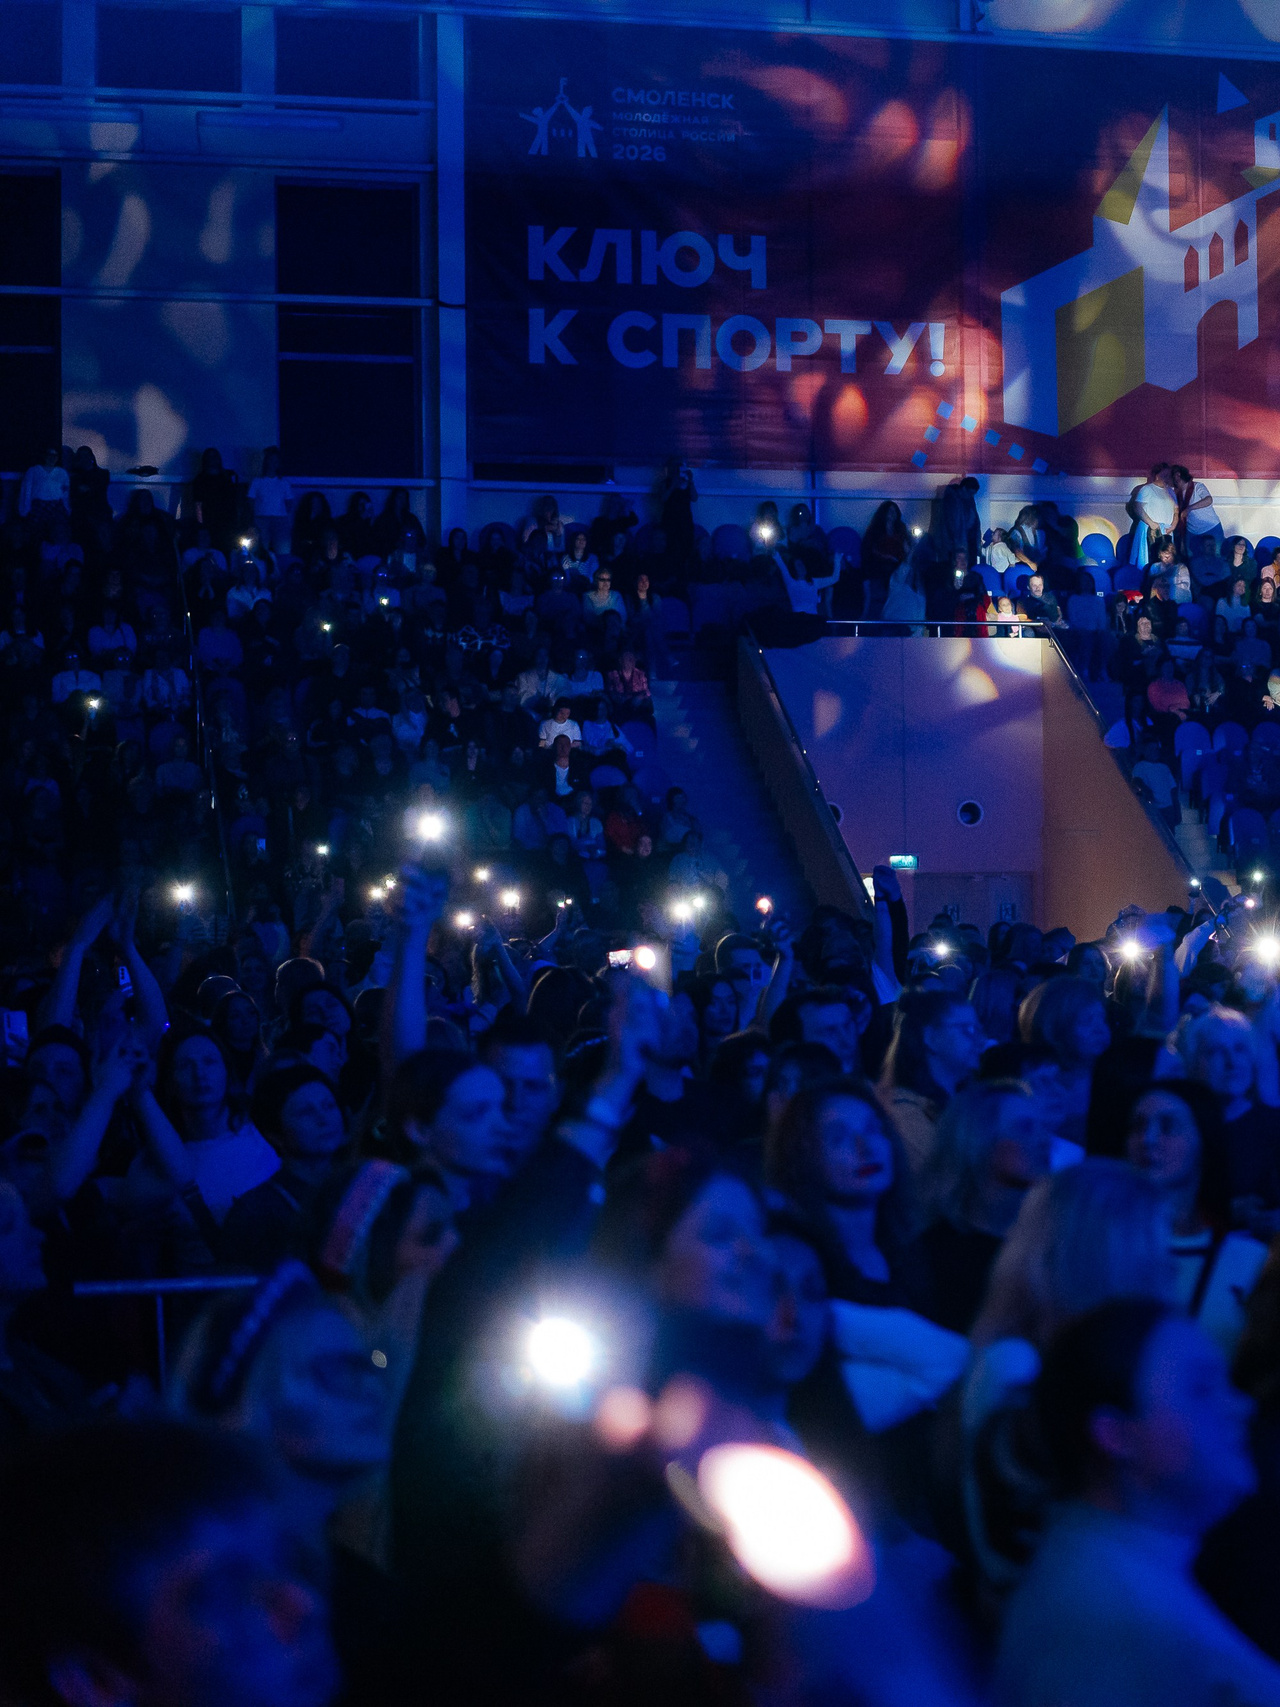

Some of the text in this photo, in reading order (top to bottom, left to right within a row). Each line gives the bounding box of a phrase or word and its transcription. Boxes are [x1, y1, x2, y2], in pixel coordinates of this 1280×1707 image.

[612, 88, 734, 109] СМОЛЕНСК
[612, 127, 736, 142] СТОЛИЦА РОССИИ
[612, 144, 667, 161] 2026
[528, 225, 767, 289] КЛЮЧ
[528, 308, 946, 377] К СПОРТУ!
